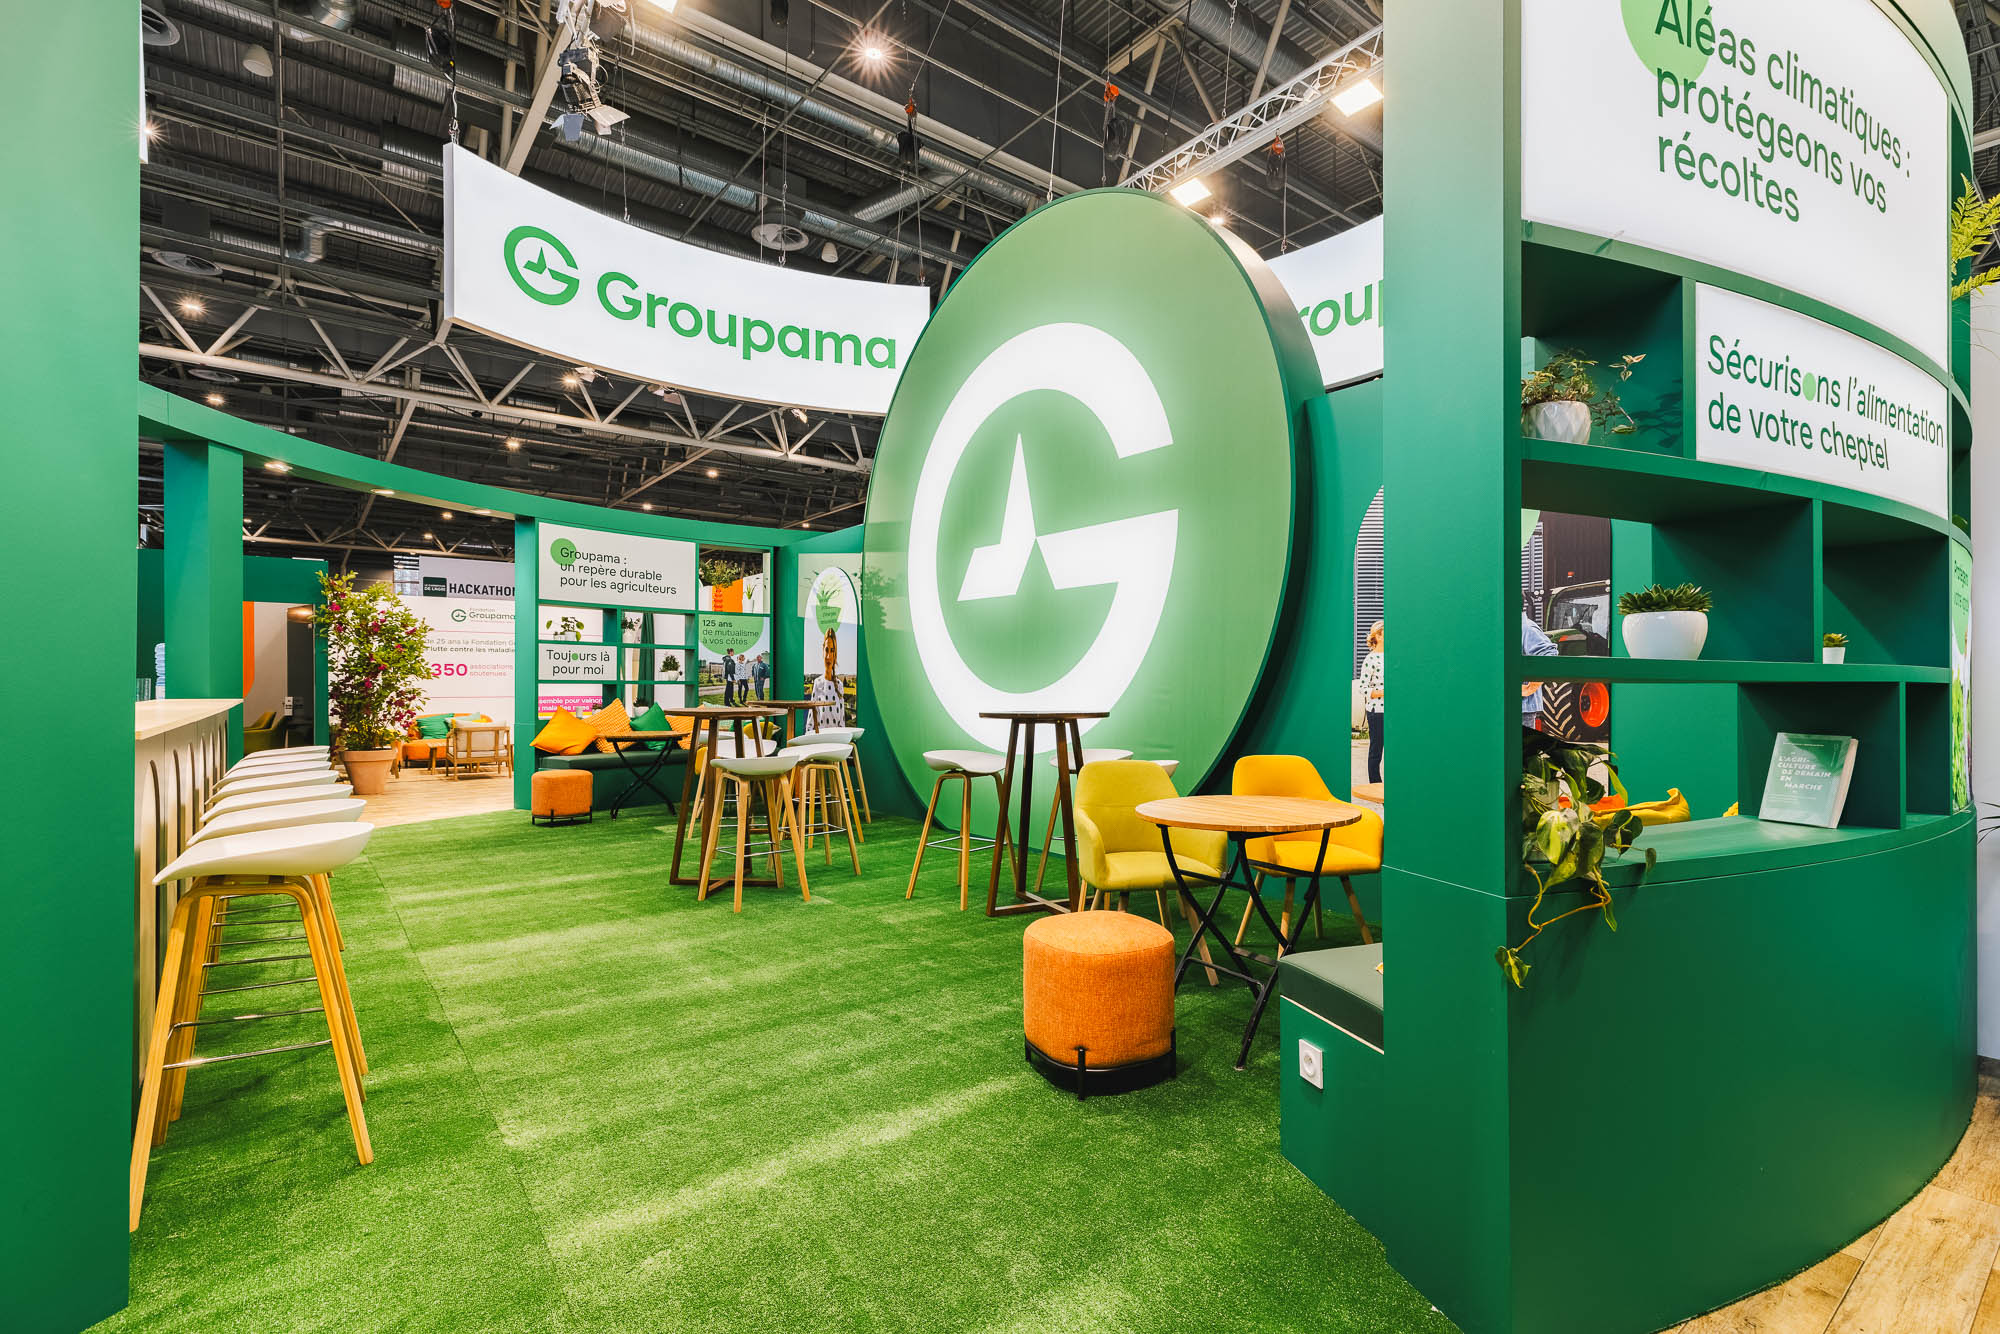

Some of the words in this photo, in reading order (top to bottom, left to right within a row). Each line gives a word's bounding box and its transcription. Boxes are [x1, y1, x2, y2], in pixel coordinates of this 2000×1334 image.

[1654, 0, 1757, 76] Aléas
[1767, 51, 1901, 169] climatiques
[1905, 151, 1911, 178] :
[1656, 67, 1843, 185] protégeons
[1850, 160, 1887, 213] vos
[1658, 131, 1800, 223] récoltes
[597, 271, 897, 370] Groupama
[1708, 334, 1841, 408] Sécurisons
[1848, 376, 1945, 449] l'alimentation
[1708, 392, 1741, 434] de
[1749, 406, 1814, 450] votre
[1820, 421, 1890, 472] cheptel
[560, 547, 621, 564] Groupama
[560, 563, 575, 573] un
[578, 565, 617, 577] repère
[620, 568, 663, 581] durable
[560, 576, 588, 588] pour
[591, 578, 607, 589] les
[610, 581, 677, 595] agriculteurs
[703, 619, 716, 627] 125
[714, 629, 759, 637] mutualisme
[726, 637, 748, 645] côtés
[546, 649, 597, 663] Toujours
[600, 651, 610, 662] là
[431, 663, 468, 677] 350
[552, 665, 580, 677] pour
[583, 664, 604, 675] moi
[1777, 762, 1817, 770] CULTURE
